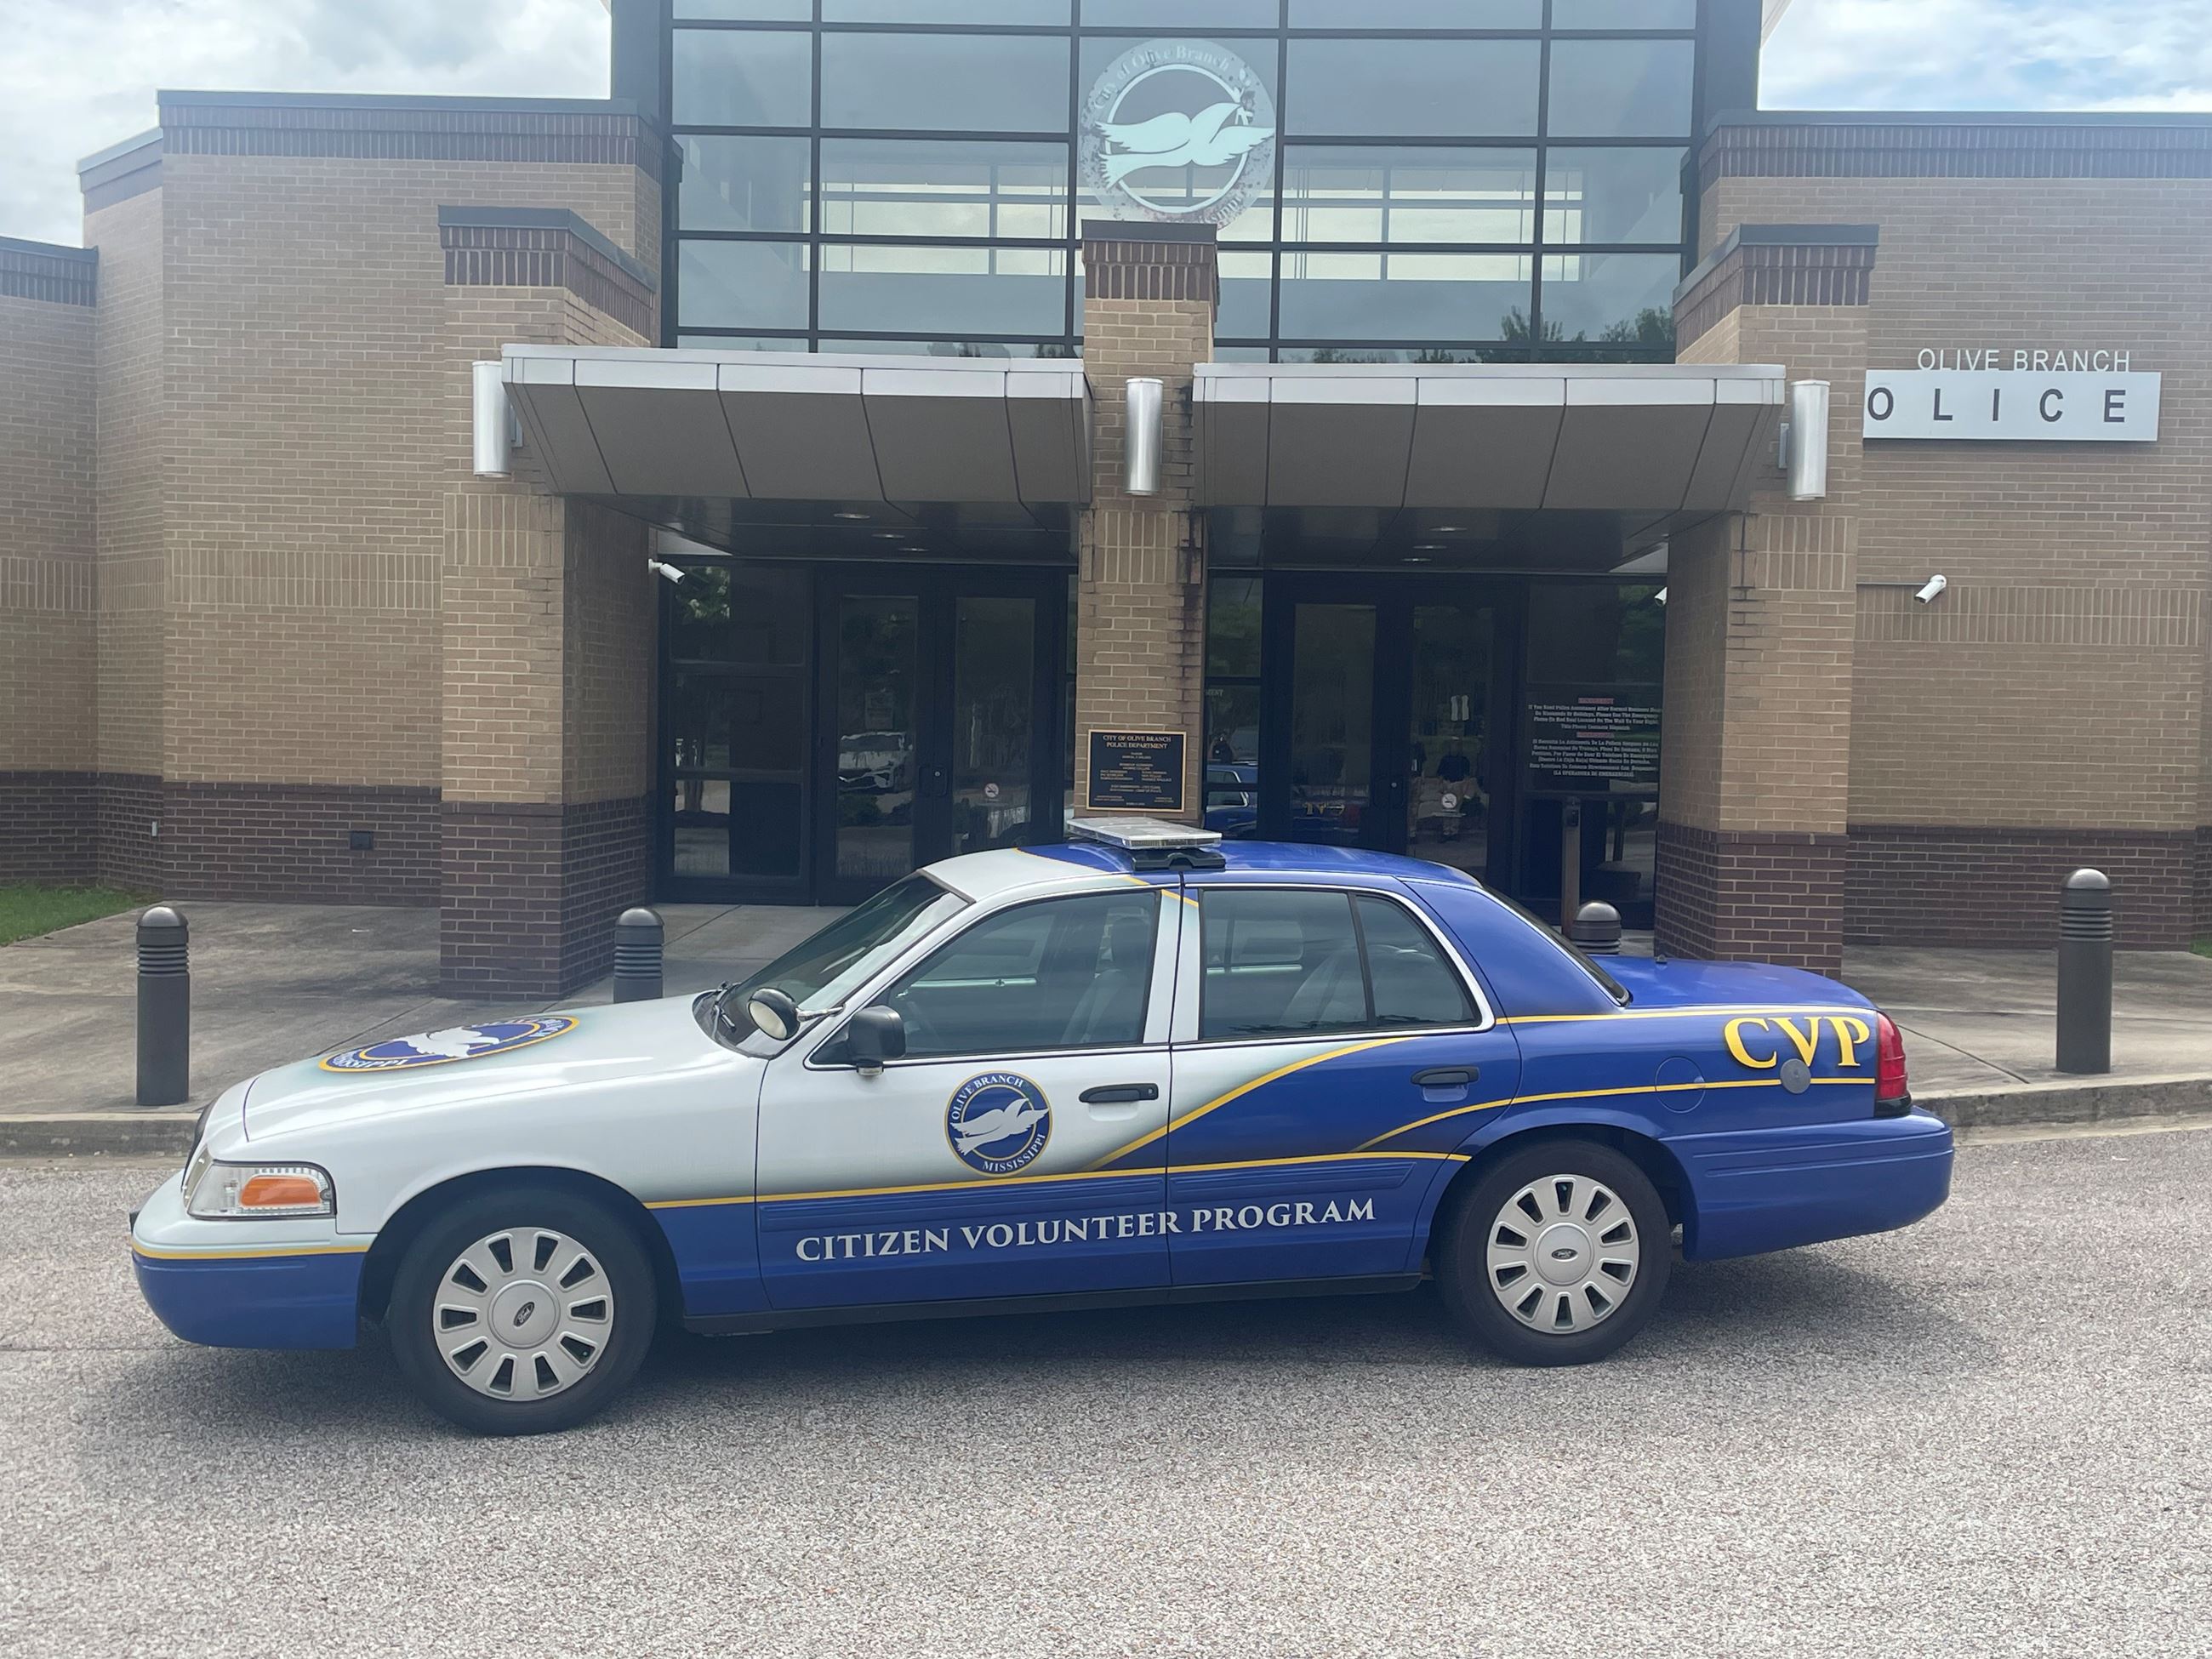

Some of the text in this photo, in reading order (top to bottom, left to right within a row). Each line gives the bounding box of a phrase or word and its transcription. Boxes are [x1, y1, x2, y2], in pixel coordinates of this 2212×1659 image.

[1177, 45, 1230, 71] Branch
[1918, 348, 2129, 372] OLIVE BRANCH
[1867, 386, 2126, 423] OLICE
[1724, 1016, 1870, 1069] CVP
[951, 1075, 1024, 1120] OLIVE BRANCH
[983, 1133, 1046, 1172] MISSISSIPPI
[795, 1198, 1377, 1263] CITIZEN VOLUNTEER PROGRAM
